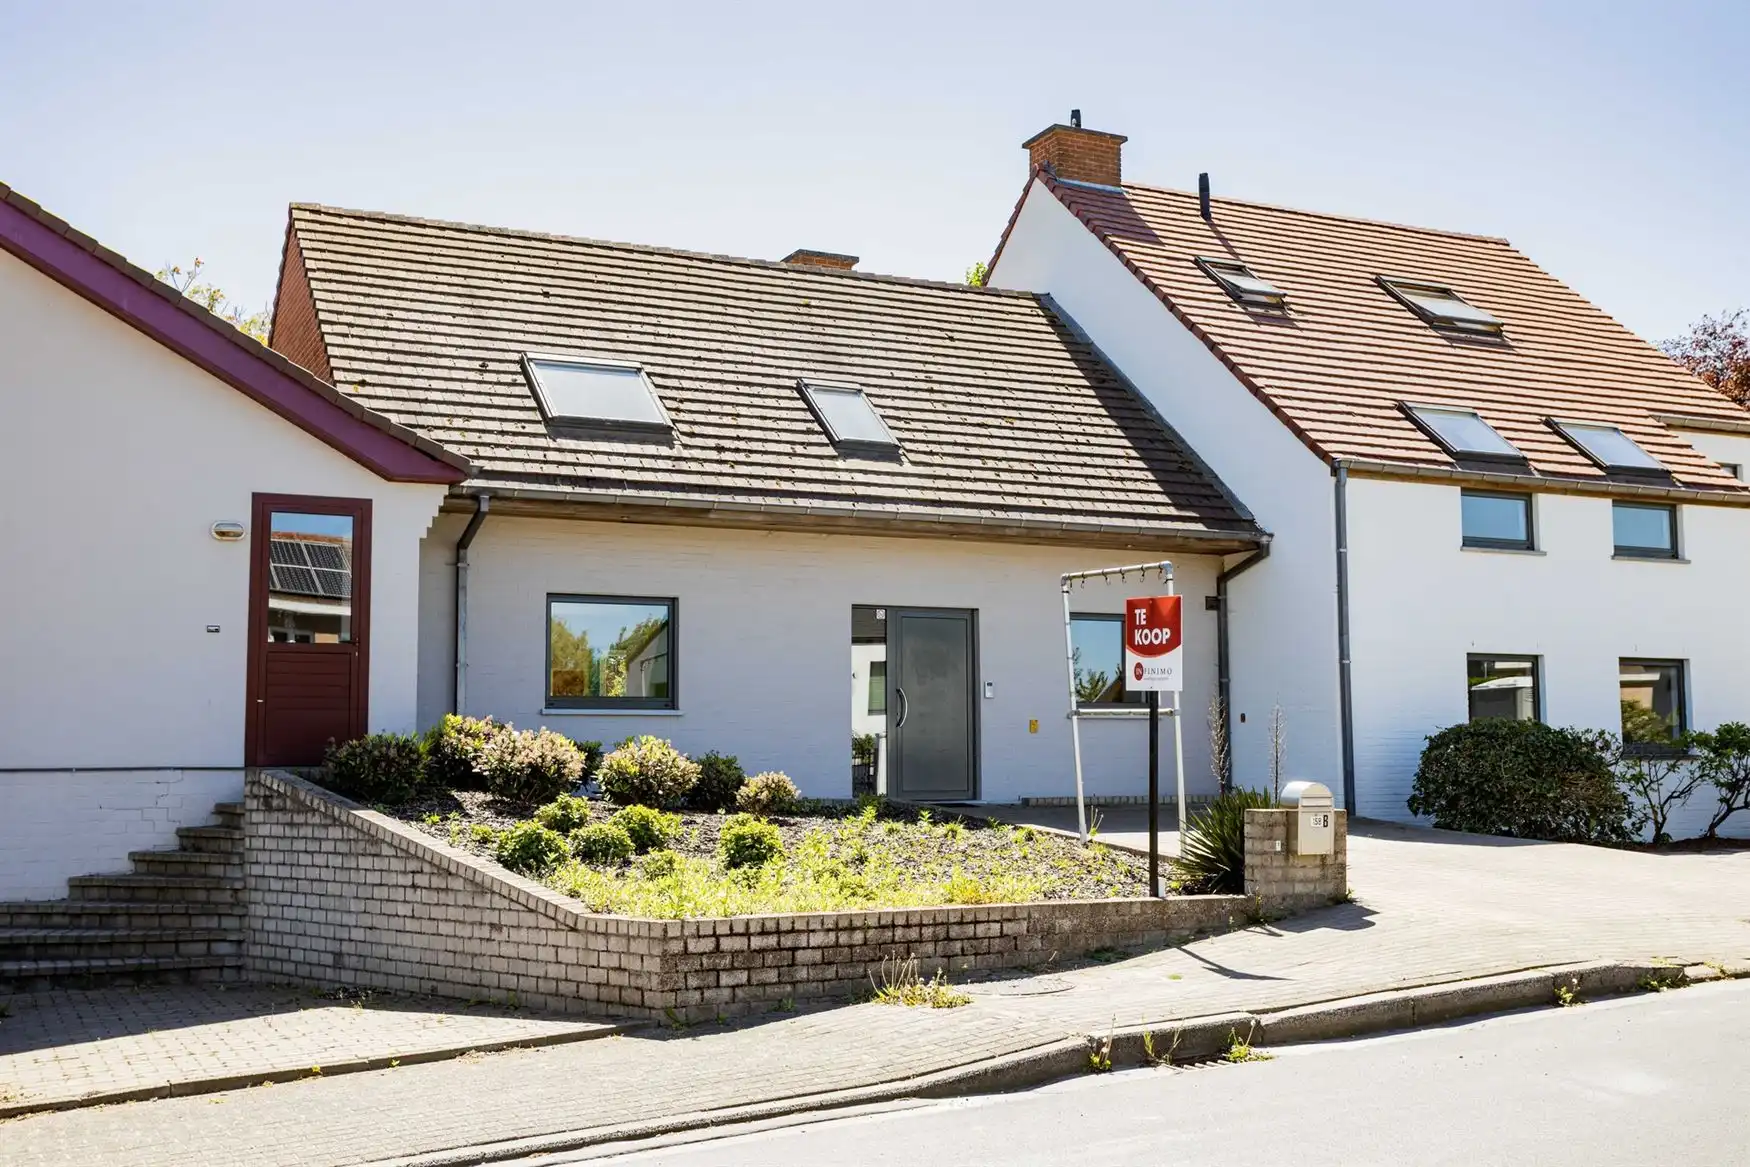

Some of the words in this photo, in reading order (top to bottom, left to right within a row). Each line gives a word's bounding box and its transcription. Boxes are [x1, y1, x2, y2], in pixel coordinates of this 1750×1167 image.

[1135, 609, 1147, 625] TE
[1135, 628, 1171, 645] KOOP
[1323, 815, 1328, 827] B
